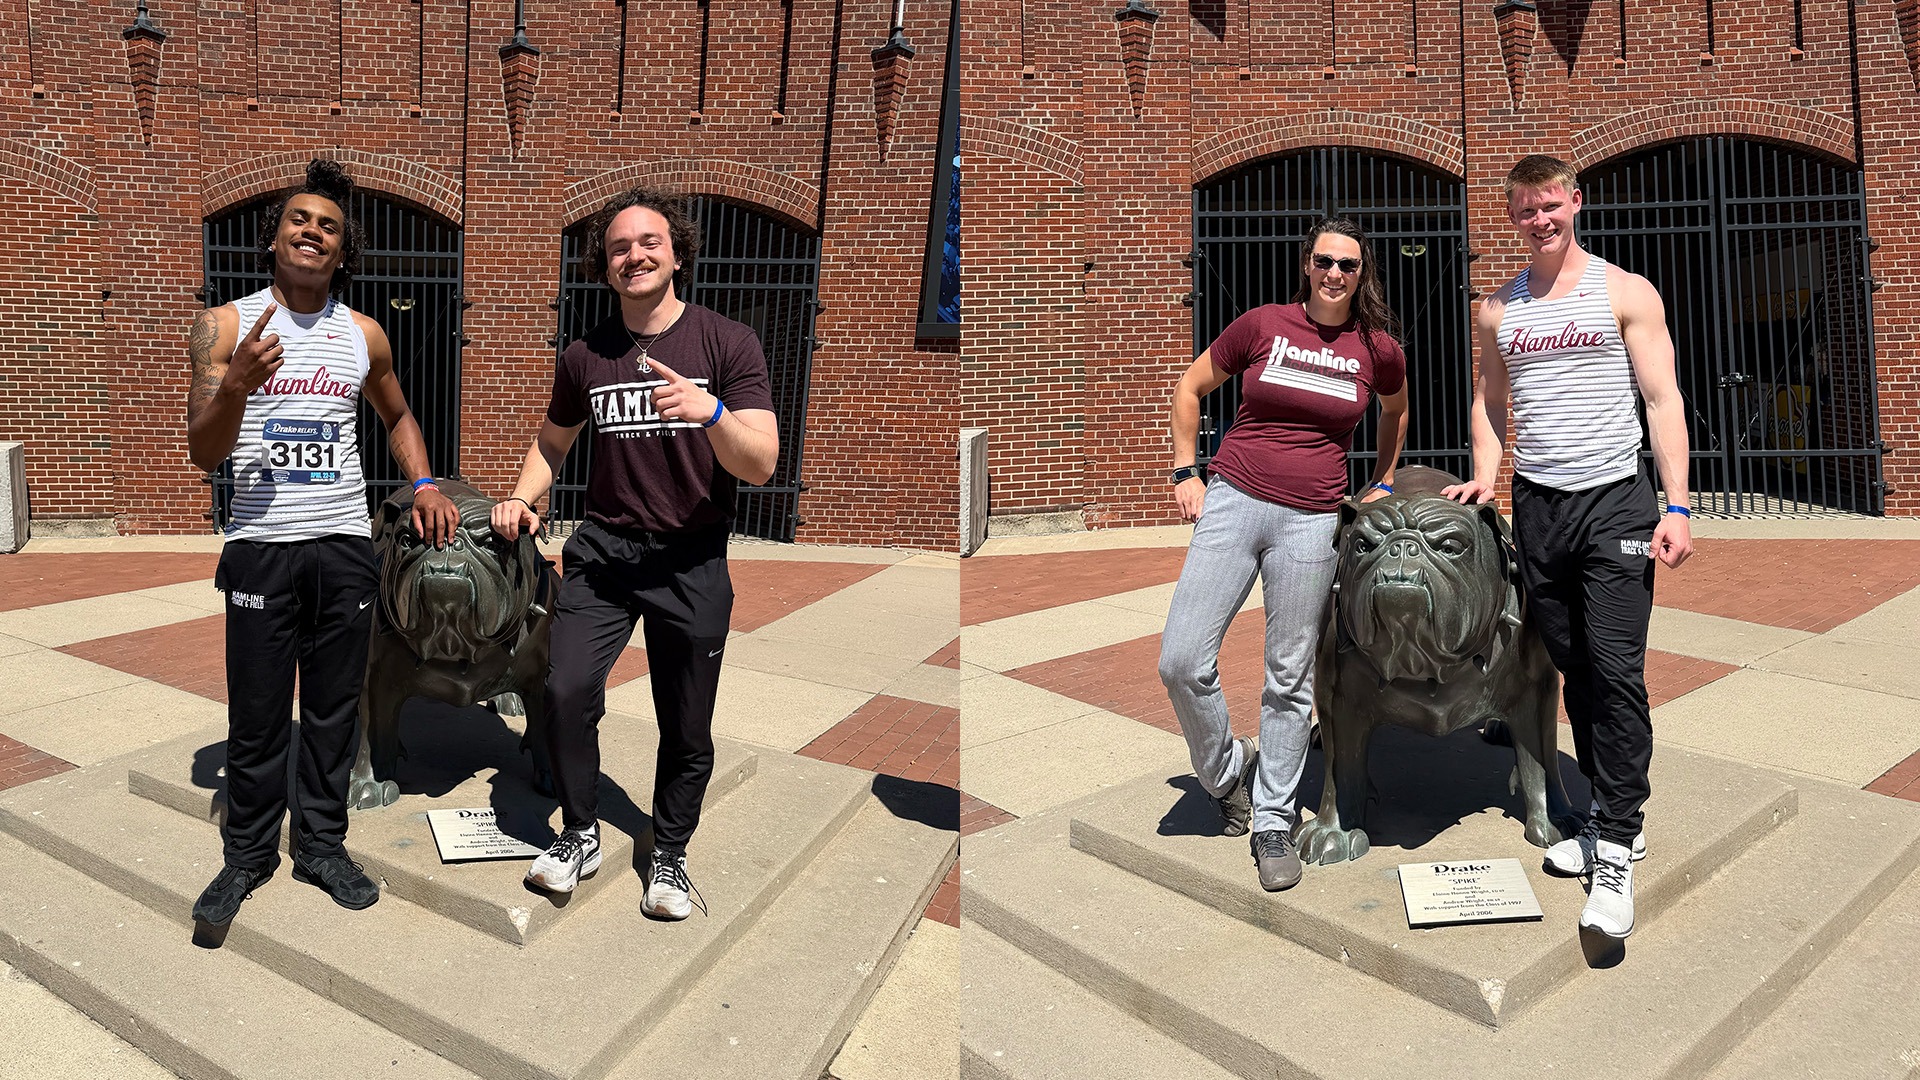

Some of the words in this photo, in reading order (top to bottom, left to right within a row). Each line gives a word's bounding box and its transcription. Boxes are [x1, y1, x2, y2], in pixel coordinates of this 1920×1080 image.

[1506, 321, 1605, 356] Hamline
[1267, 336, 1360, 374] Hamline
[590, 388, 708, 426] HAML
[272, 422, 297, 434] Drake
[270, 442, 334, 468] 3131
[232, 591, 264, 602] HAMLINE
[455, 809, 508, 818] Drake
[1430, 864, 1491, 873] Drake
